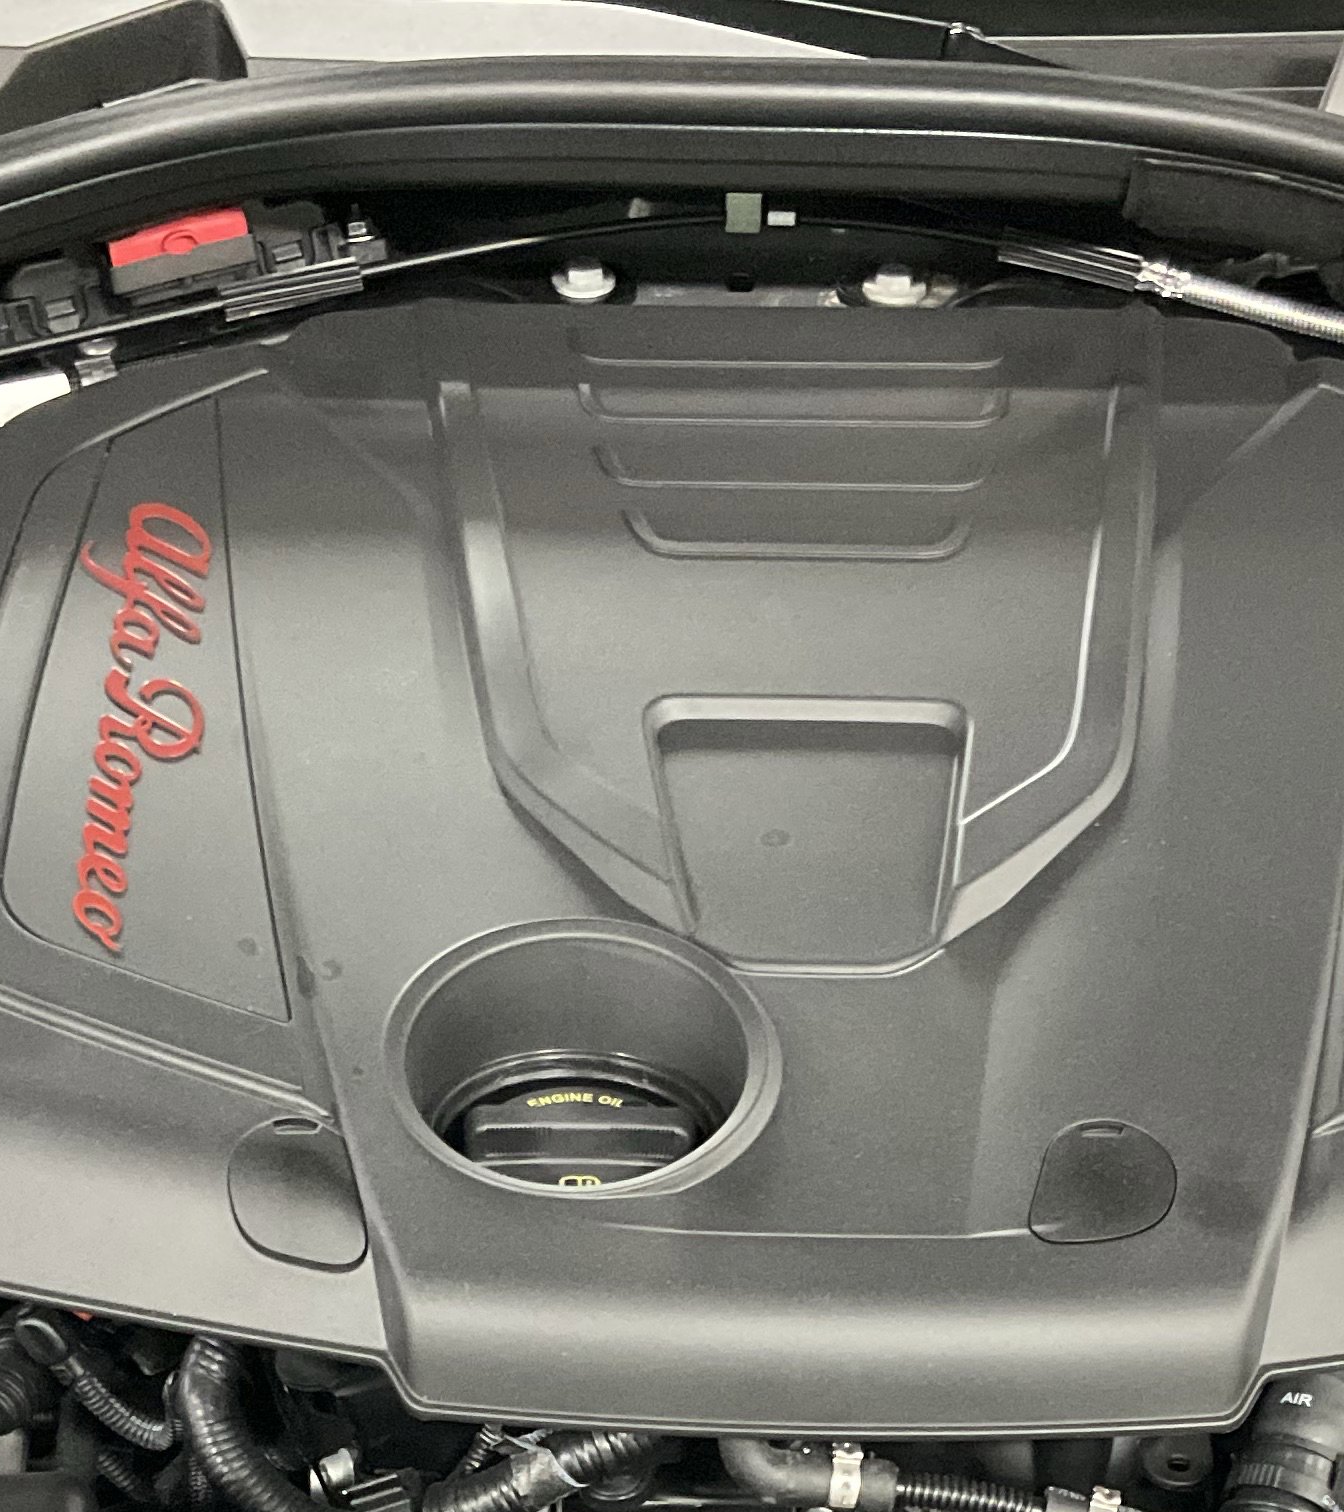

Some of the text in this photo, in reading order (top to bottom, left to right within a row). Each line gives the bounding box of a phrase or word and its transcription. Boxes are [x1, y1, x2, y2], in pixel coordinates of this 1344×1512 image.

[72, 502, 213, 953] Alfa Romeo
[526, 1092, 624, 1108] ENGINE OIL
[1279, 1391, 1314, 1408] AIR
